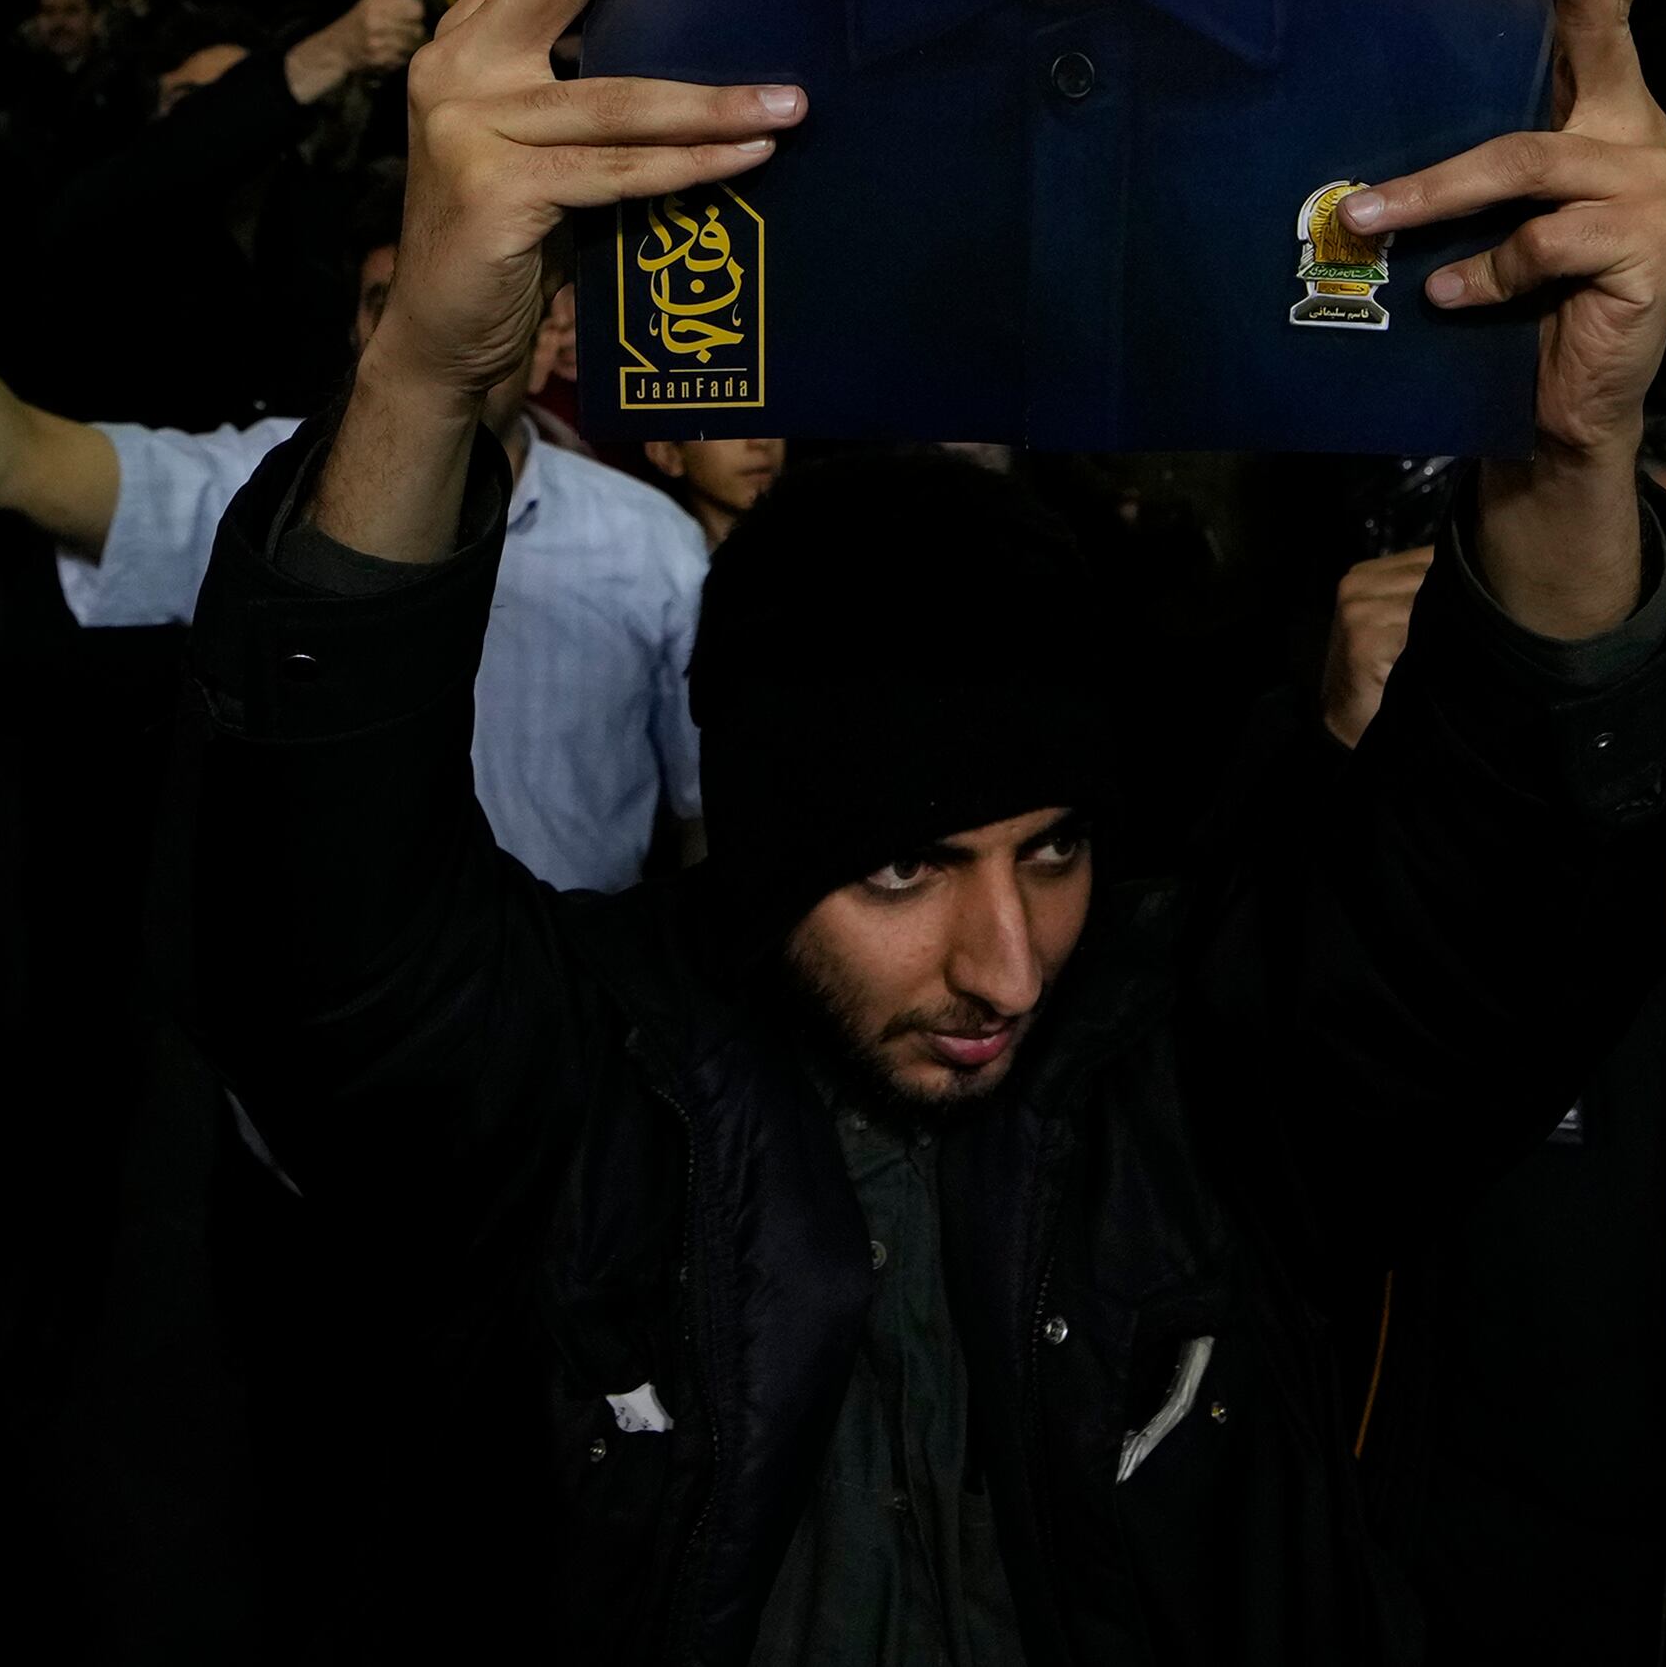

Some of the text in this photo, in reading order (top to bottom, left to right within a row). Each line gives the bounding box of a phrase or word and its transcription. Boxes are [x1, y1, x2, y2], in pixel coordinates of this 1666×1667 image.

[1308, 306, 1370, 320] قاسم سلیمانی
[636, 377, 748, 400] JaanFada
